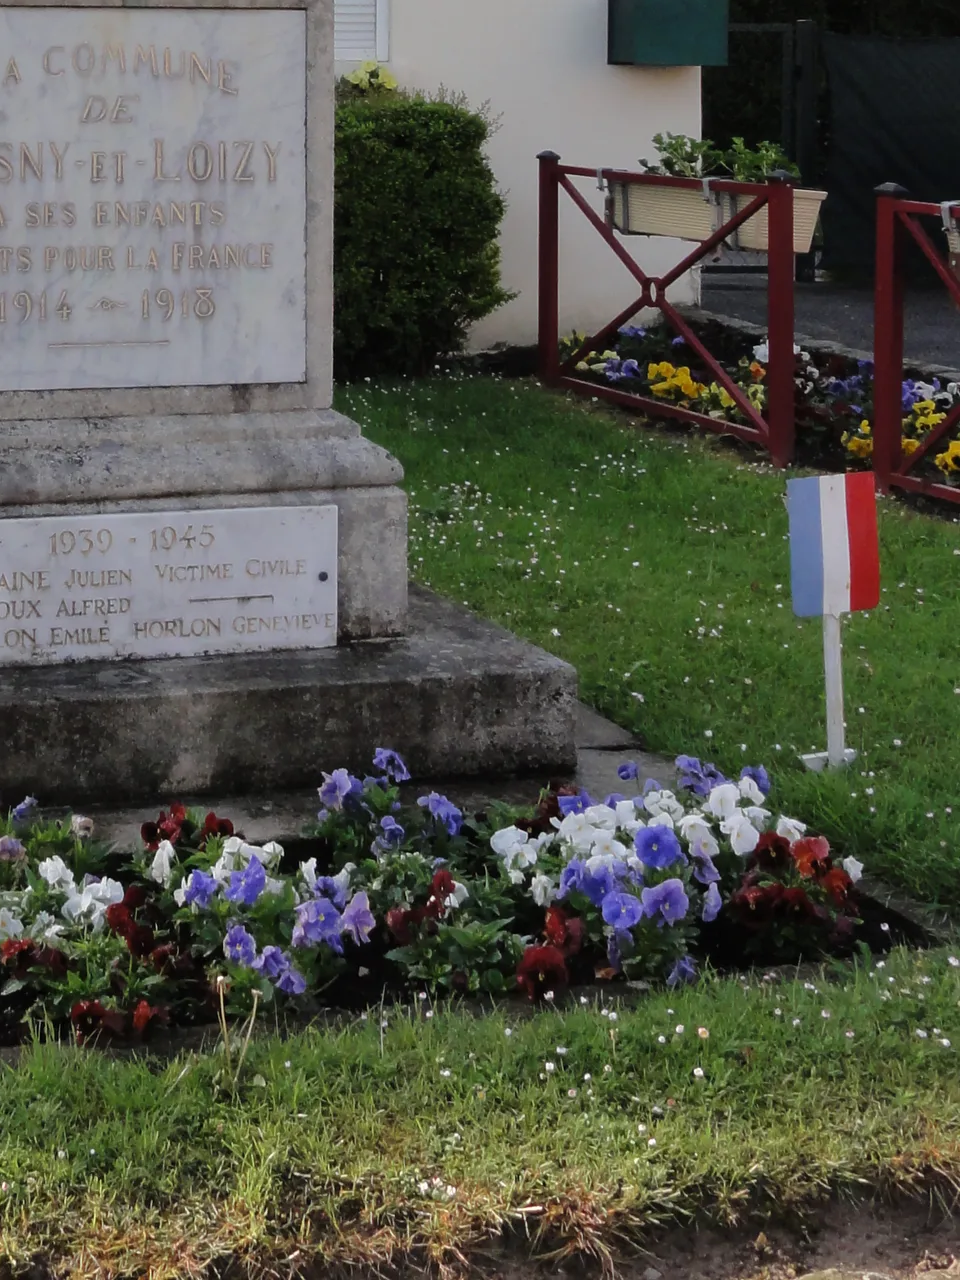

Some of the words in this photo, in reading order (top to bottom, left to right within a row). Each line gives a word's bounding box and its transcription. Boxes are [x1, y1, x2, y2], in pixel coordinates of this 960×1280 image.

[42, 43, 240, 96] COMMUNE
[80, 94, 140, 124] DE
[25, 201, 77, 227] SES
[95, 200, 227, 227] ENFANTS
[44, 245, 116, 272] POUR
[126, 245, 160, 271] LA
[171, 242, 274, 271] FRANCE
[140, 287, 218, 320] 1918
[49, 528, 114, 556] 1939
[150, 525, 216, 551] 1945
[64, 569, 134, 588] JULIEN
[154, 563, 234, 583] VICTIME
[245, 558, 308, 578] CIVILE
[56, 597, 132, 618] ALFRED
[133, 617, 221, 640] HORLON
